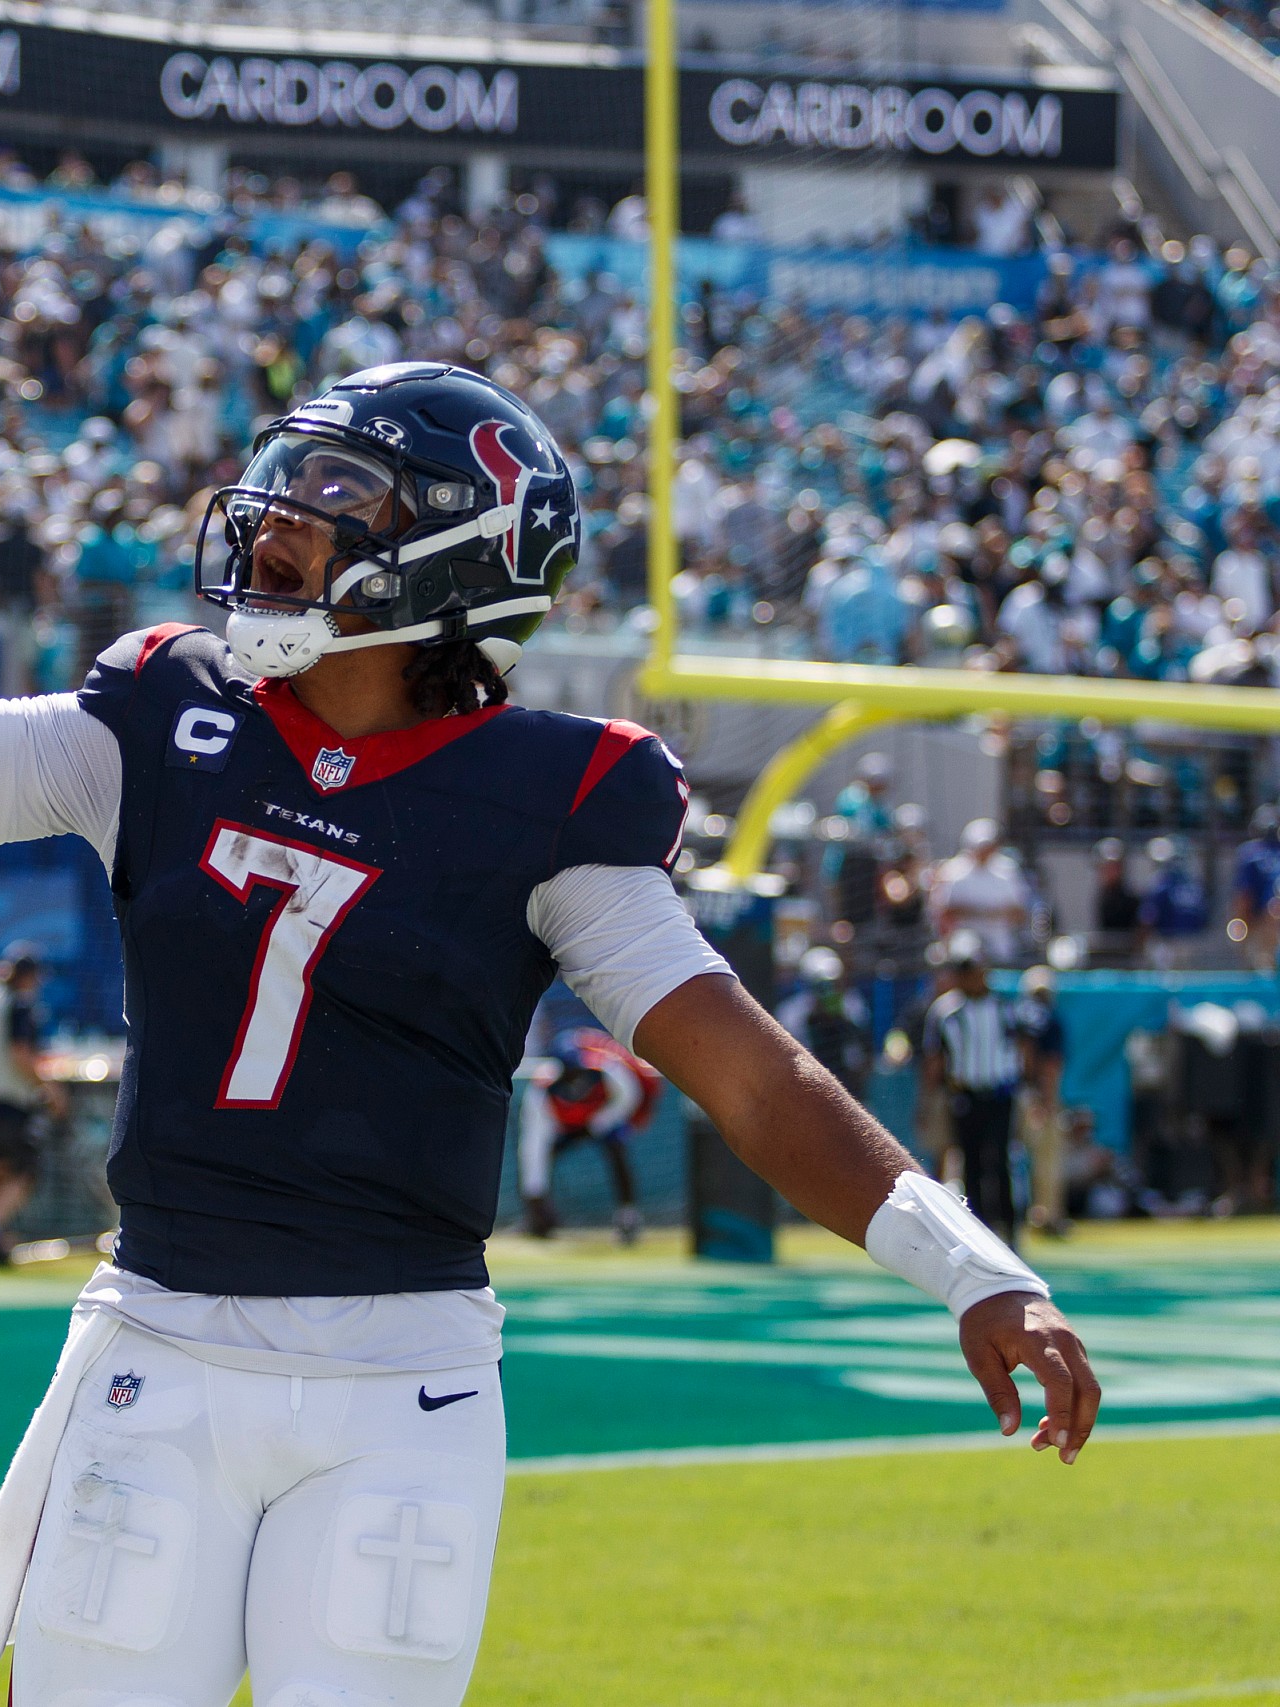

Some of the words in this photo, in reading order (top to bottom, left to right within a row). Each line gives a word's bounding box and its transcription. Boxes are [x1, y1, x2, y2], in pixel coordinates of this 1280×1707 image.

[160, 51, 518, 134] CARDROOM
[708, 78, 1063, 158] CARDROOM
[174, 707, 236, 755] C
[318, 762, 342, 782] NFL
[262, 801, 362, 844] TEXANS
[198, 817, 384, 1110] 7
[110, 1387, 133, 1405] NFL
